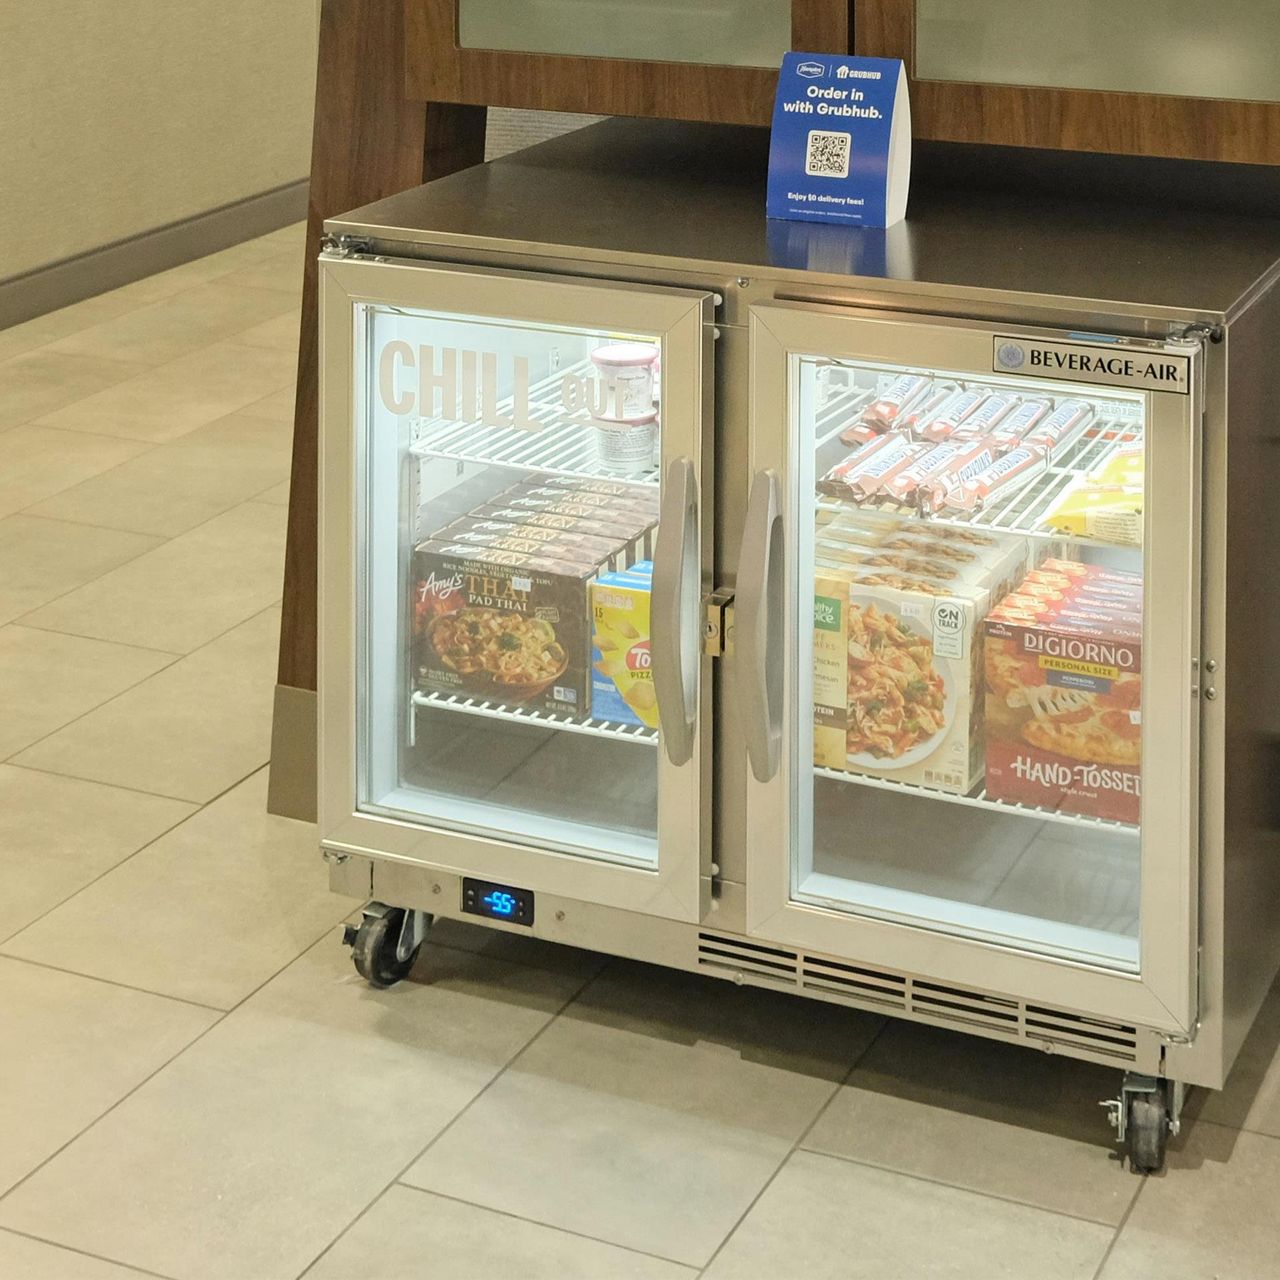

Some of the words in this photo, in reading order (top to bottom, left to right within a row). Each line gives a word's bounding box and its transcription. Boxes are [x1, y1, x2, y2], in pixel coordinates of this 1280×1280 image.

[849, 70, 882, 80] GRUBHUB
[806, 85, 848, 99] Order
[851, 88, 864, 101] in
[783, 101, 814, 114] with
[816, 103, 883, 119] Grubhub.
[787, 192, 807, 202] Enjoy
[808, 193, 817, 202] $0
[817, 195, 846, 205] delivery
[1030, 349, 1178, 382] BEVERAGE-AIR
[378, 339, 545, 433] CHILL
[561, 373, 628, 420] OUT
[442, 562, 457, 570] RICE
[464, 560, 481, 568] MADE
[420, 571, 465, 602] Amy's
[469, 594, 493, 606] PAD
[496, 598, 527, 612] THAI
[594, 607, 604, 618] 15
[938, 607, 959, 621] ON
[938, 619, 959, 629] TRACK
[1024, 633, 1133, 667] DIGIORNO
[1044, 658, 1091, 673] PERSONAL
[1094, 667, 1113, 676] SIZE
[630, 671, 651, 679] PIZZ
[815, 706, 835, 716] TEIN
[1060, 786, 1078, 795] style
[1078, 789, 1098, 798] crust
